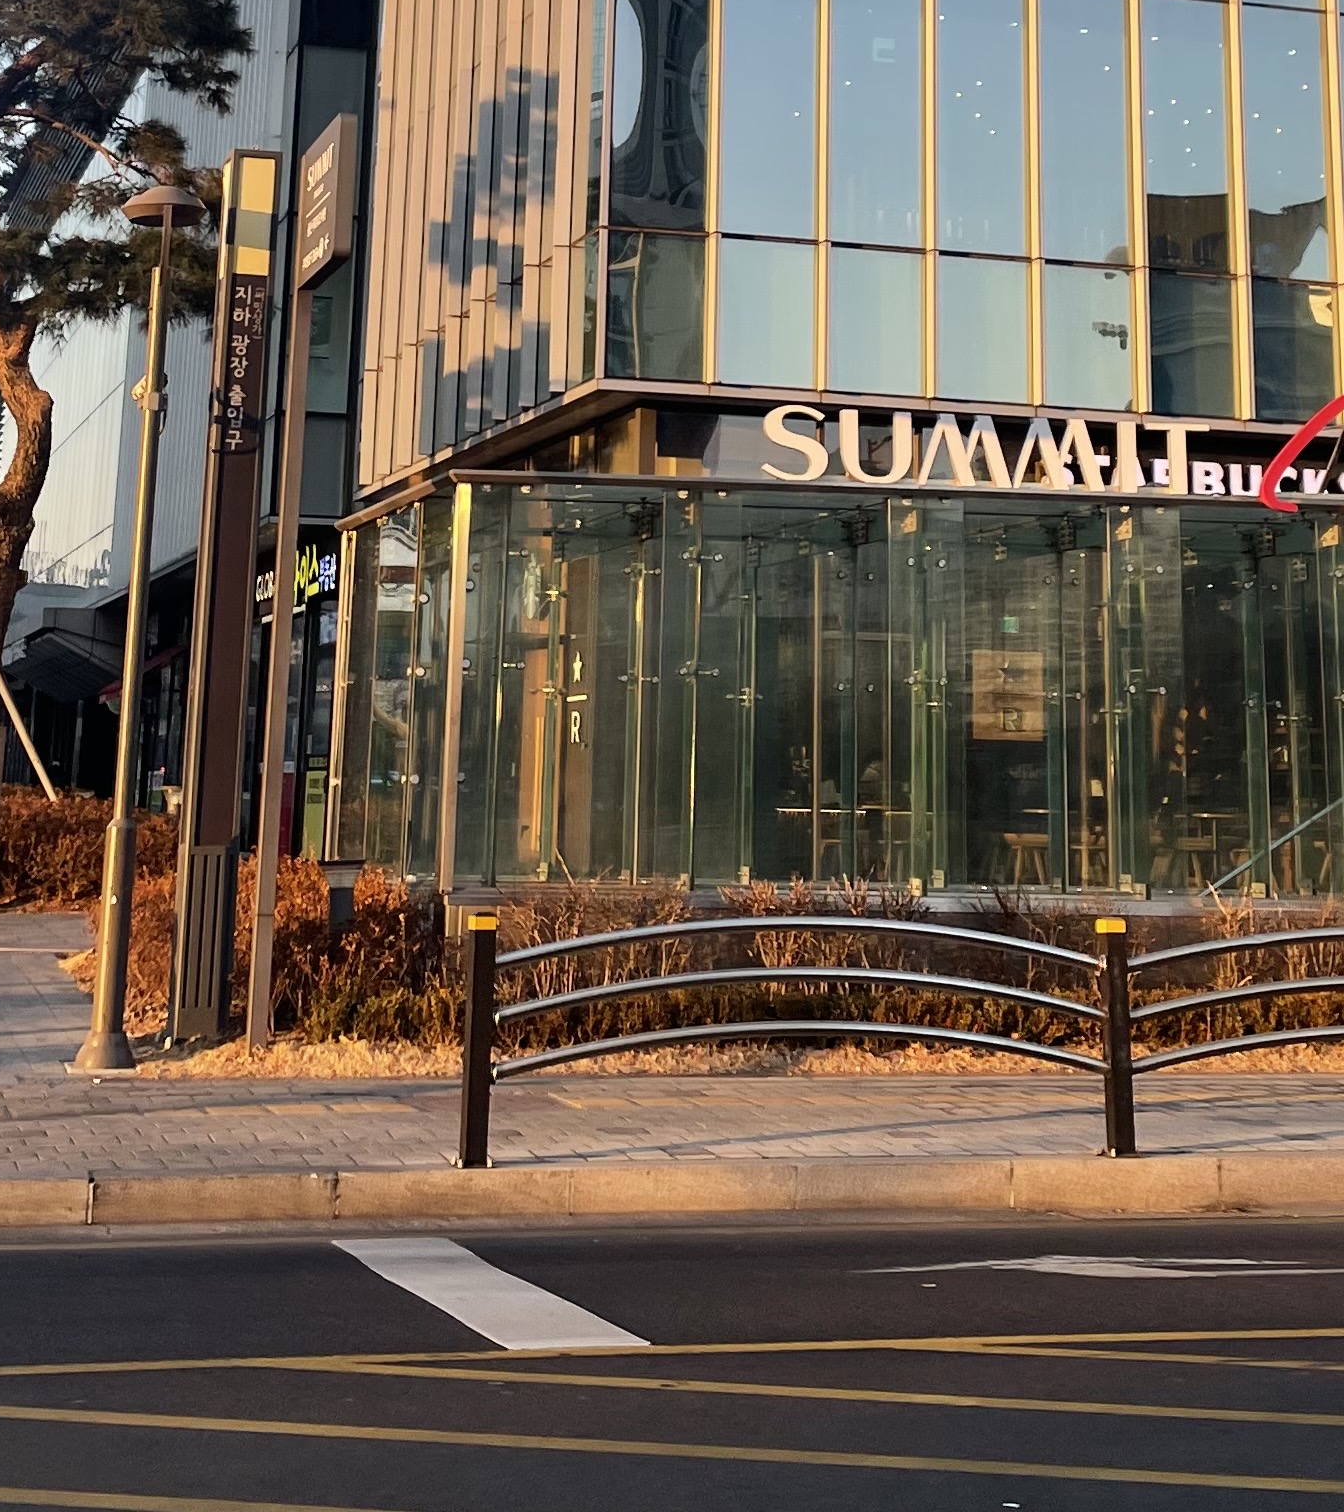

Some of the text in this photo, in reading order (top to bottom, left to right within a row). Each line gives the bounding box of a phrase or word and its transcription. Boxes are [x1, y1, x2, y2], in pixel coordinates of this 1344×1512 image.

[224, 285, 252, 452] 지하 광장 출입구
[760, 404, 1210, 495] SUMMIT
